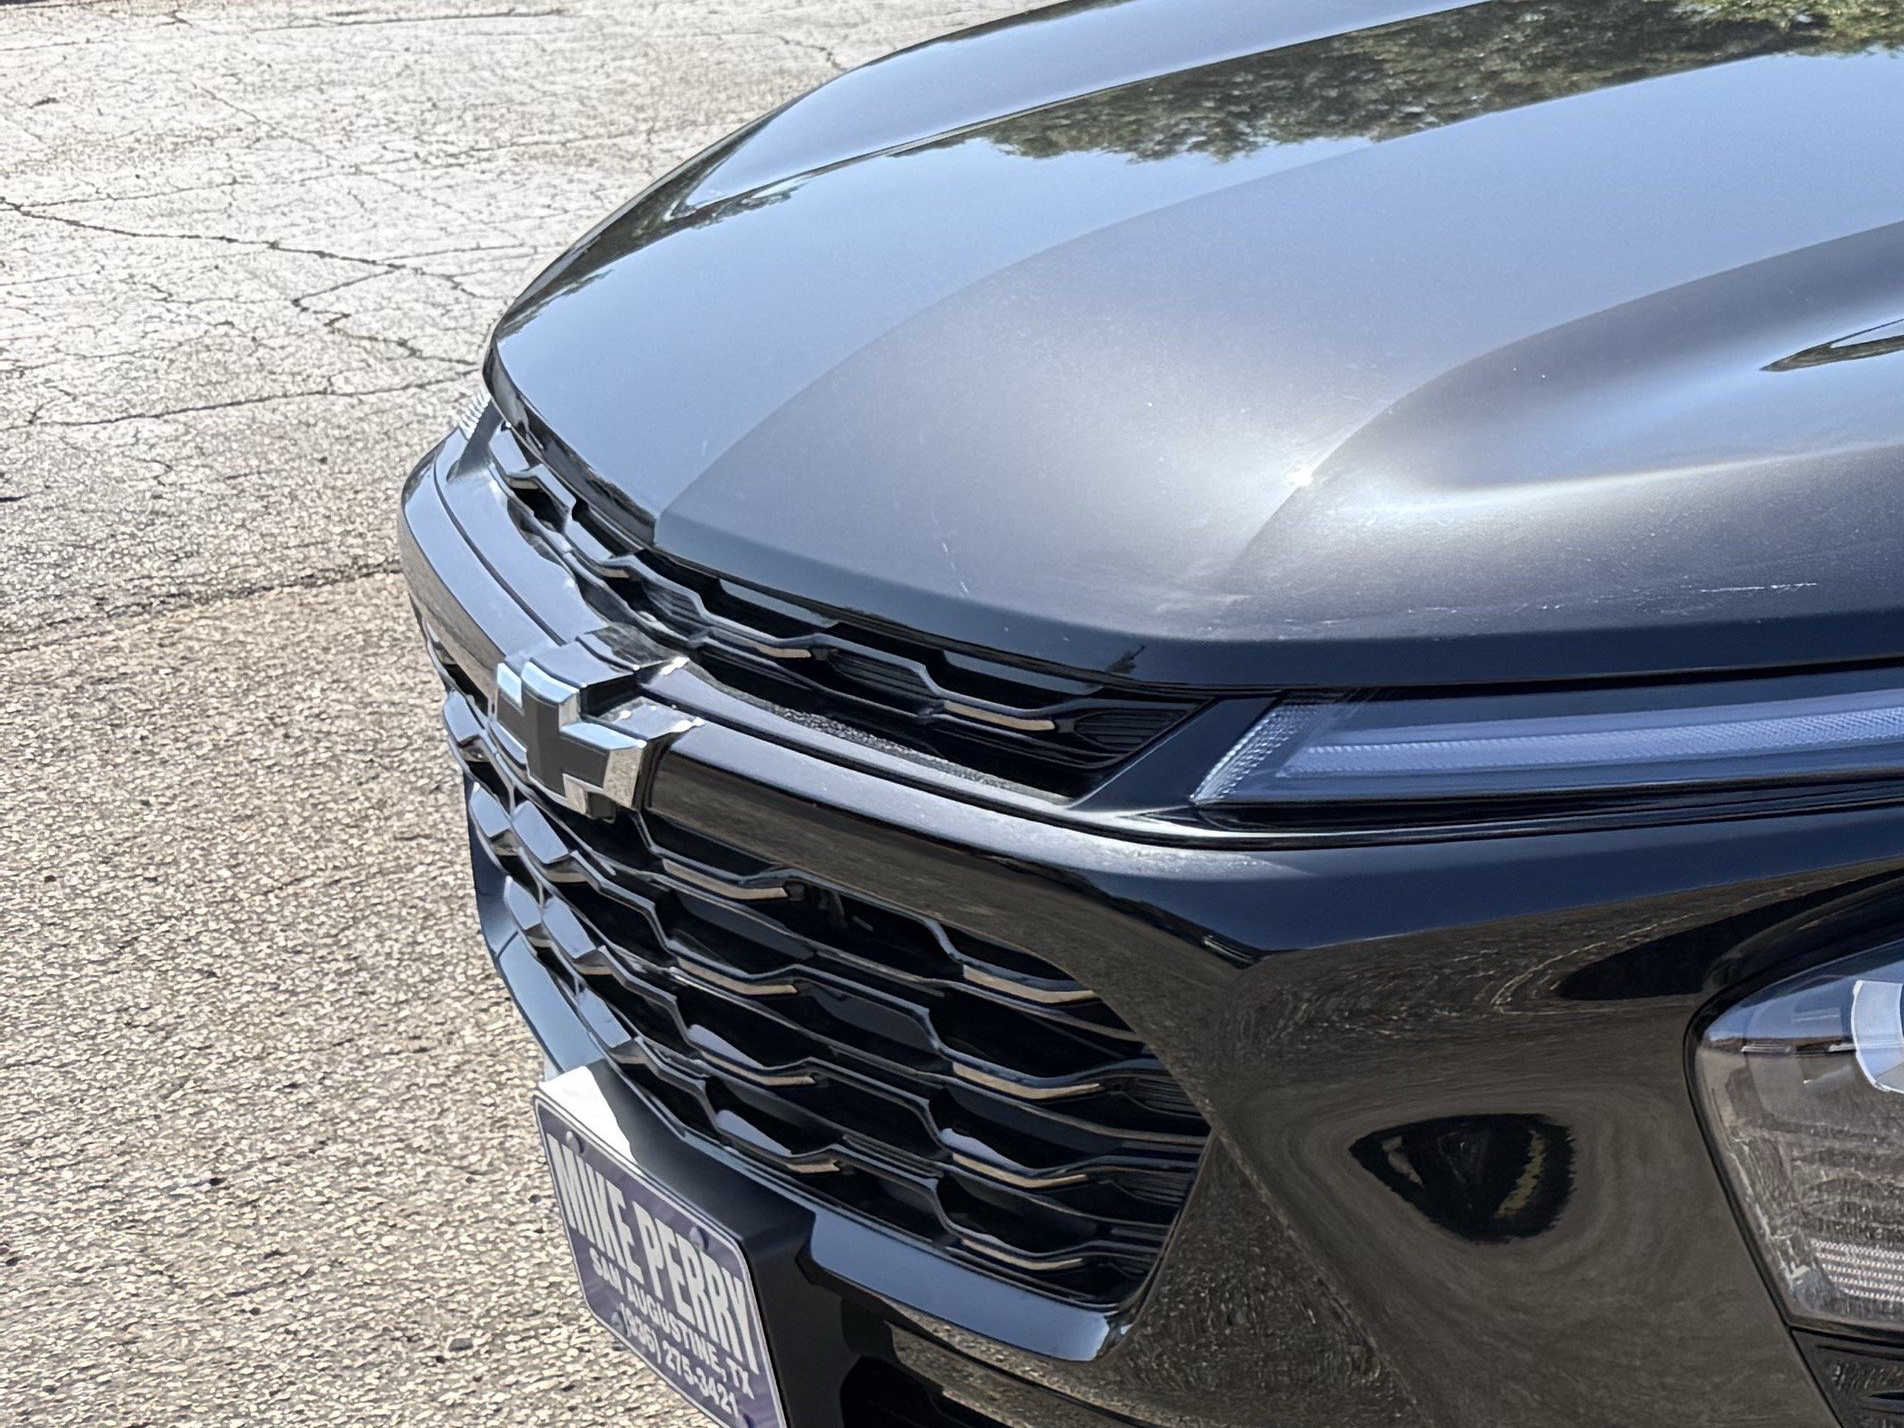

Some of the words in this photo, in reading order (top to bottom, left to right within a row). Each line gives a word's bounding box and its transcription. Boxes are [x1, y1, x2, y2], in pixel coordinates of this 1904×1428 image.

[547, 1133, 645, 1285] MIKE
[632, 1200, 760, 1375] PERRY
[590, 1247, 624, 1295] SAN
[726, 1357, 755, 1400] TX
[665, 1338, 740, 1416] 275-3421
